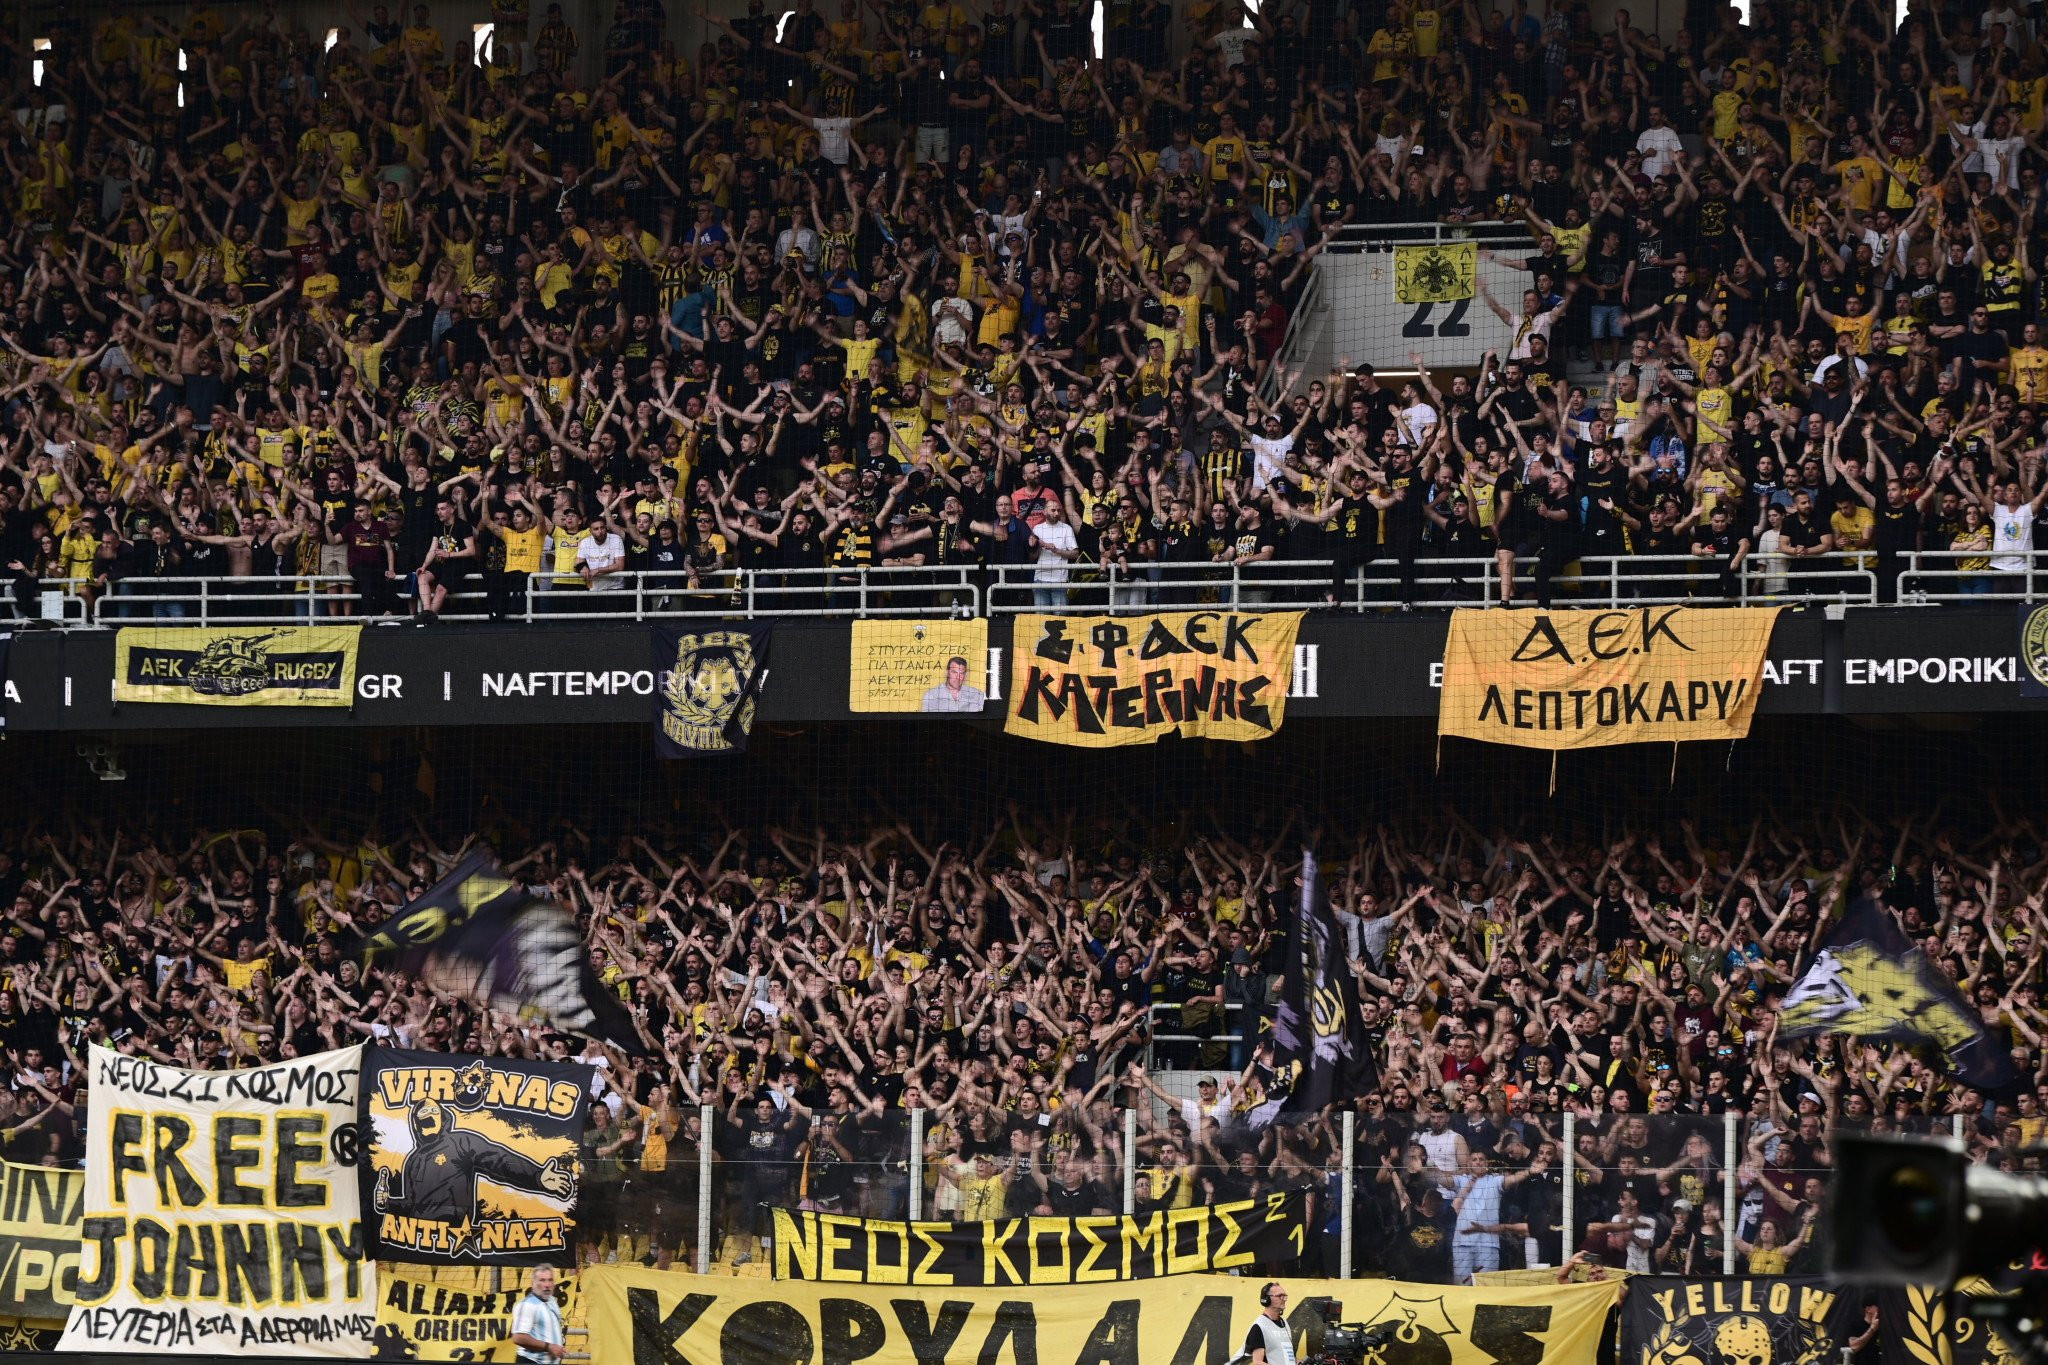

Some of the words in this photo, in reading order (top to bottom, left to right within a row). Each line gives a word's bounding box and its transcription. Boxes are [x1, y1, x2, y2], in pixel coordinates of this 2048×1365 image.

[140, 657, 184, 678] AEK
[274, 661, 337, 681] RUGBY
[868, 659, 888, 671] ΓΙΑ
[894, 659, 943, 670] ΠΑΝΤΑ
[938, 644, 970, 655] ΖΕΙΣ
[867, 674, 933, 685] ΑΕΚΤΖΗΣ
[226, 1064, 359, 1107] ΚΟΣΜΟΣ
[111, 1108, 331, 1210] FREE
[381, 1213, 449, 1252] ANTI
[481, 1219, 566, 1254] NAZI
[772, 1207, 955, 1285] ΝΕΟΣ
[982, 1199, 1256, 1287] ΚΟΣΜΟΣ
[76, 1213, 366, 1308] JOHNNY
[1651, 1280, 1836, 1323] YELLOW
[71, 1307, 194, 1346] ΛΕΥΤΕΡΙΑ
[195, 1313, 236, 1338] ΣΤΑ
[414, 1318, 514, 1342] ORIGIN
